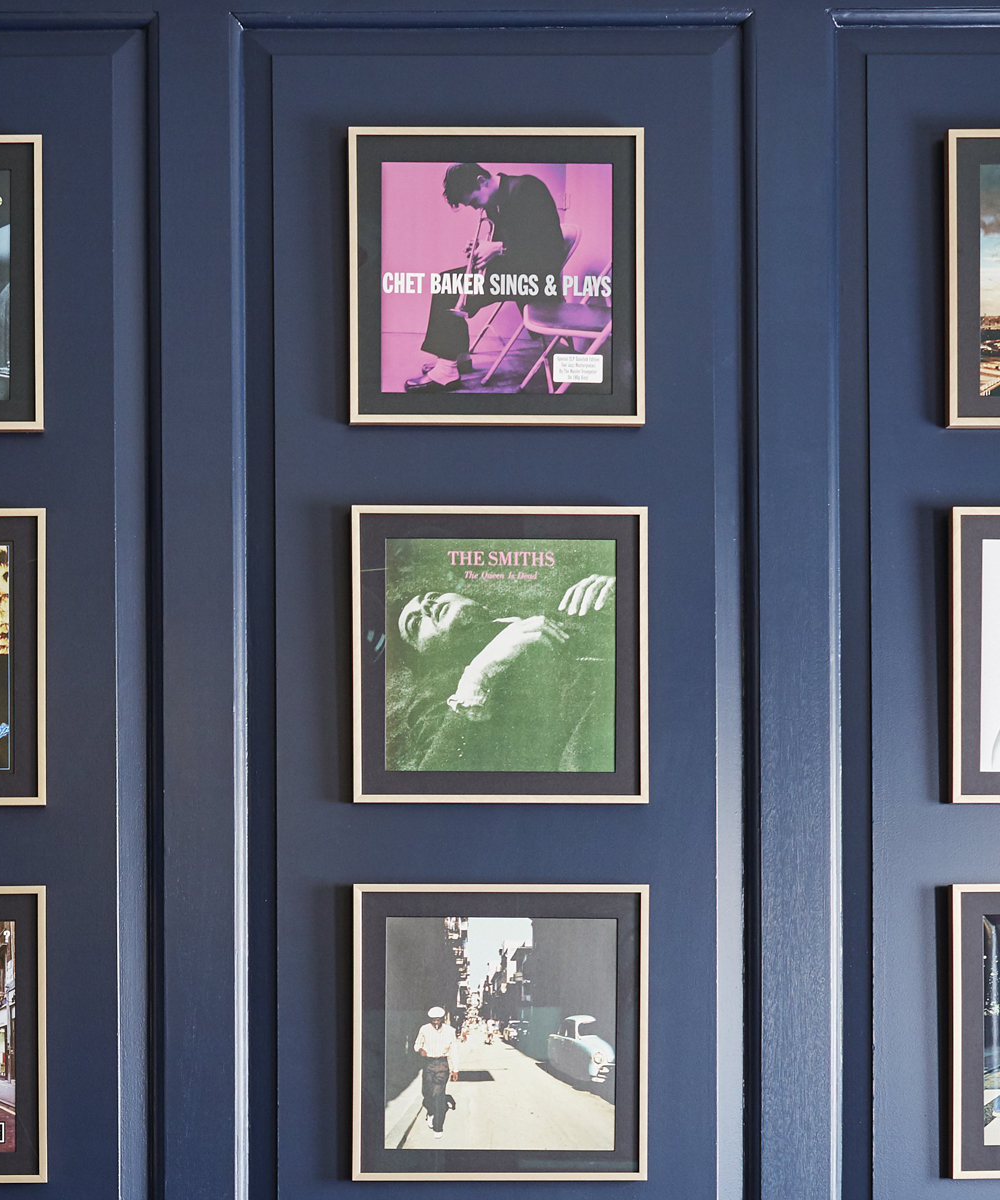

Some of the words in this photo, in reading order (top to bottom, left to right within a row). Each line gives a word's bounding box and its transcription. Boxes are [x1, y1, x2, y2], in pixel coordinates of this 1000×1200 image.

[382, 272, 425, 294] CHET
[430, 273, 485, 295] BAKER
[489, 274, 539, 296] SINGS
[544, 274, 557, 296] &
[562, 275, 612, 298] PLAYS
[447, 551, 485, 566] THE
[488, 551, 556, 567] SMITHS
[465, 570, 478, 579] The
[481, 571, 504, 581] Queen
[508, 571, 516, 579] Is
[517, 571, 538, 580] Dead
[3, 930, 11, 943] ?
